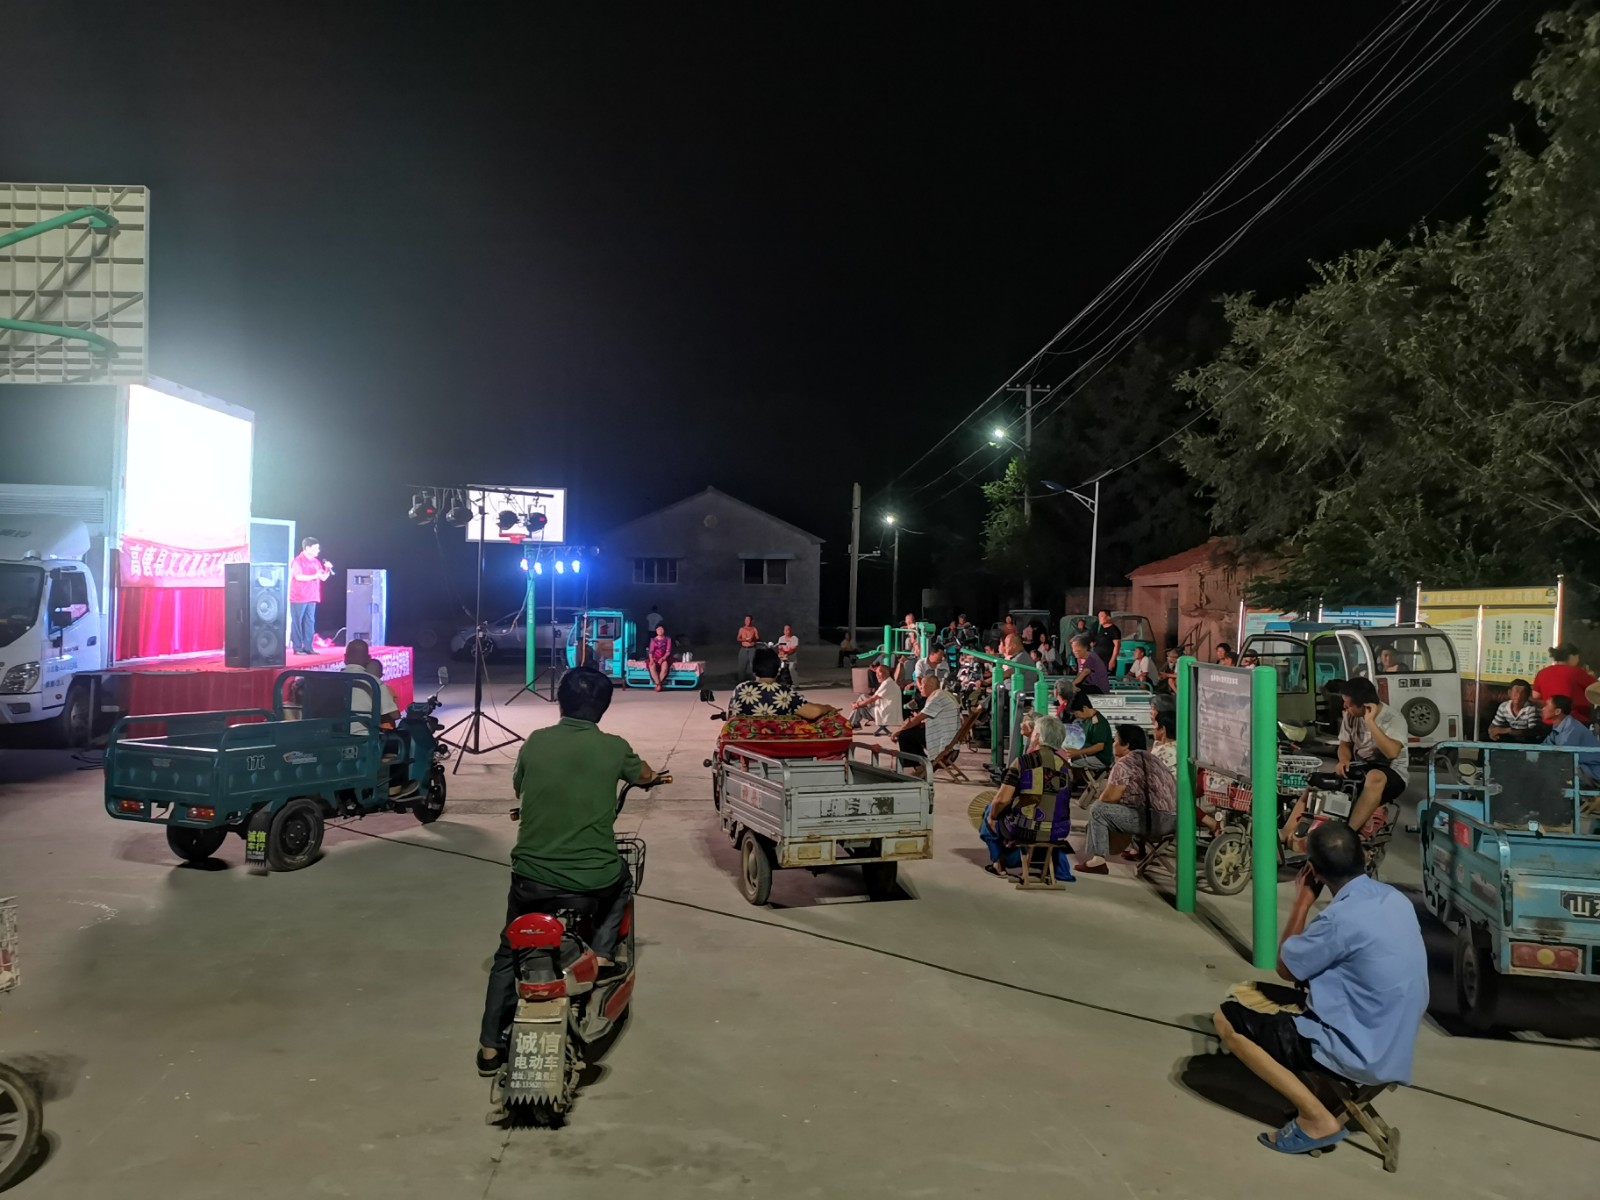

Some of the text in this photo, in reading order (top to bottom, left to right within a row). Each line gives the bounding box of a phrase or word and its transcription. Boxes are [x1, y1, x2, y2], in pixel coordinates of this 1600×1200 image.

[515, 1032, 561, 1054] 诚信
[514, 1054, 559, 1070] 电动车
